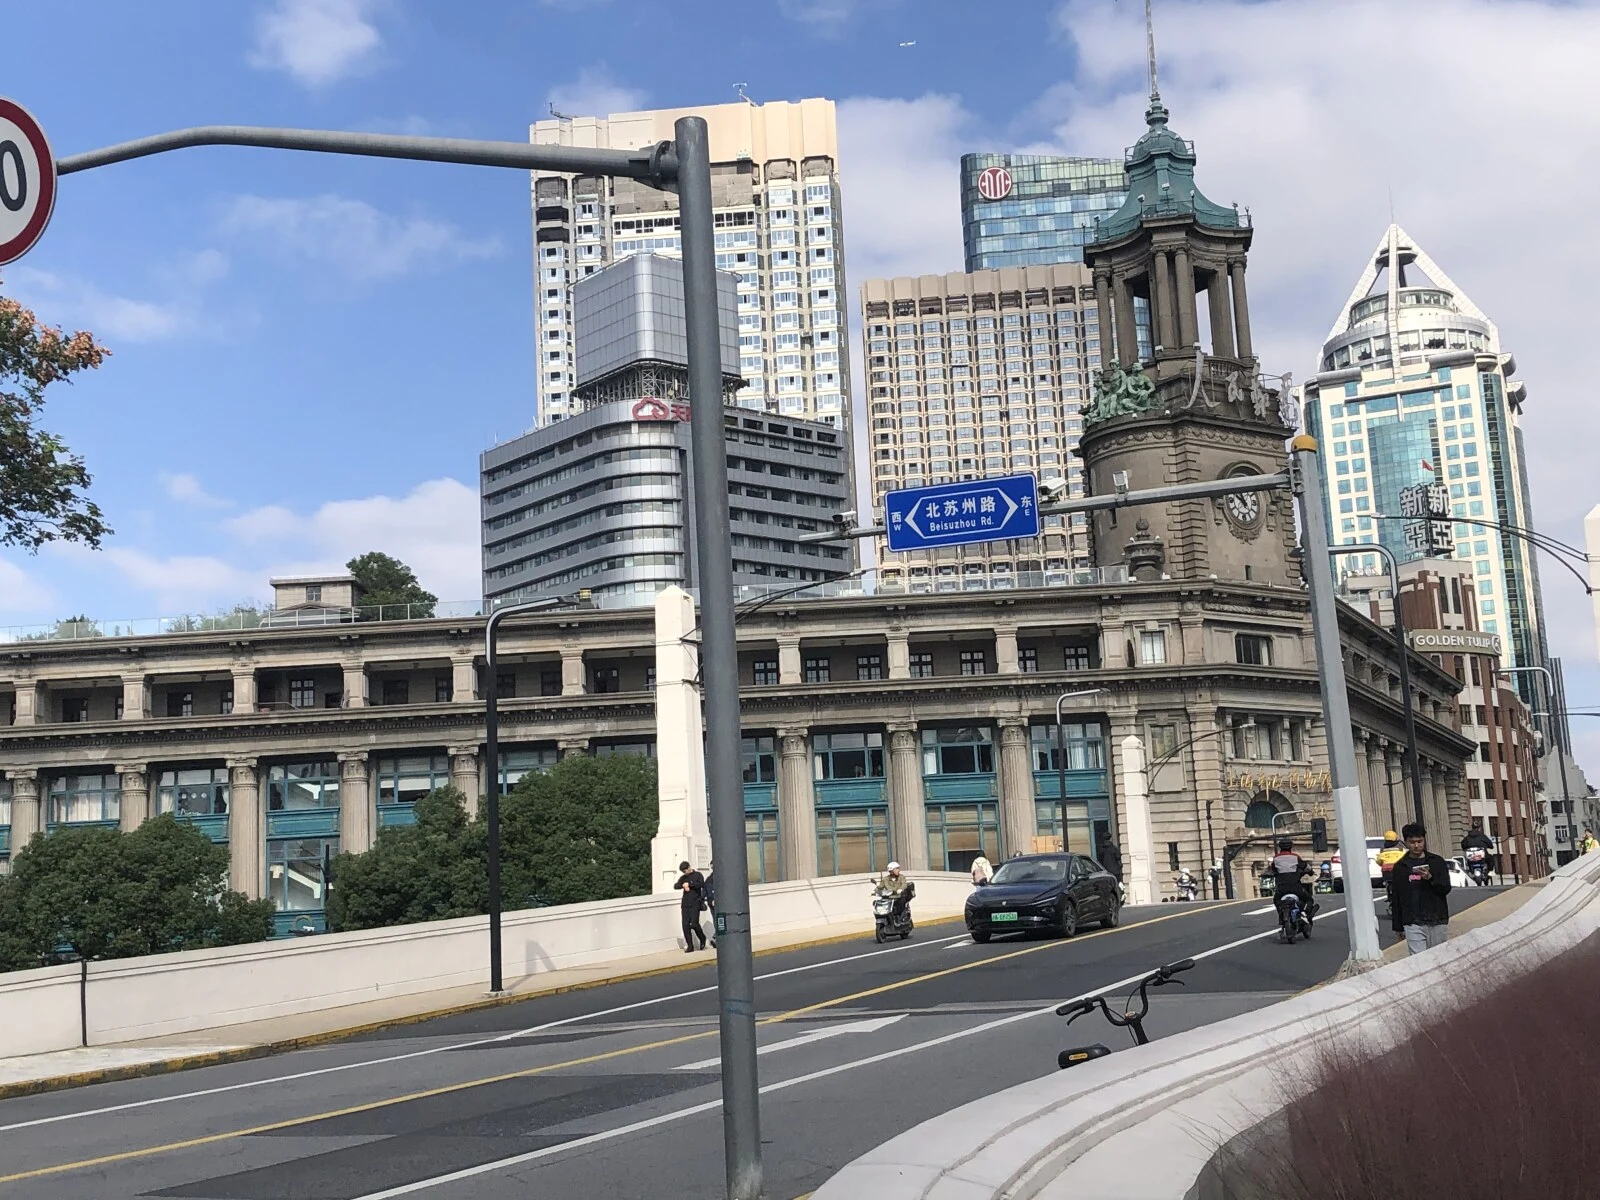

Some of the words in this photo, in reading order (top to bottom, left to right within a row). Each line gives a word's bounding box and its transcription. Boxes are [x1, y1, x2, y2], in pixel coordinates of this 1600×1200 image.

[925, 495, 997, 519] 北苏州路
[1020, 495, 1033, 508] 东
[890, 511, 902, 523] 西
[929, 520, 977, 532] Beisuzhou
[980, 515, 995, 527] Rd.
[1415, 634, 1465, 647] GOLDEN
[1466, 635, 1492, 648] TULIP
